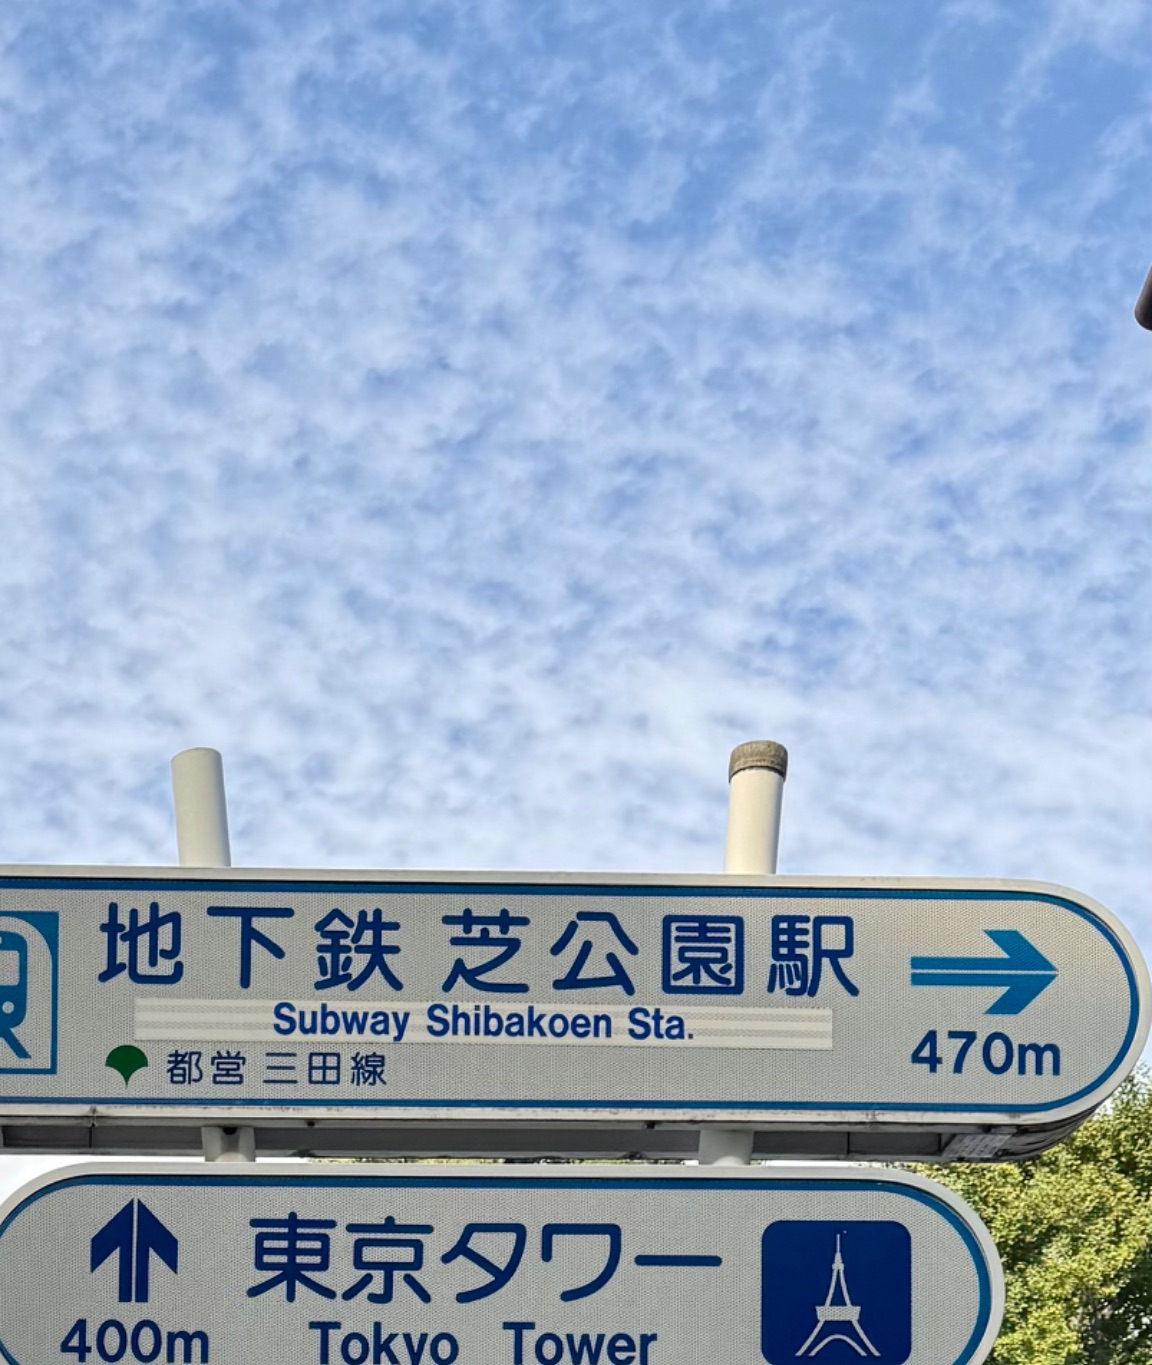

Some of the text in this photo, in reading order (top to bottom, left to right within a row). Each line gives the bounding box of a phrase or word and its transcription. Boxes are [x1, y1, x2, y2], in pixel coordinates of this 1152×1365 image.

[97, 901, 859, 998] 地下鉄芝公園駅
[273, 1002, 694, 1042] Subway Shibakoen Sta.
[910, 1029, 1062, 1077] 470m
[246, 1211, 722, 1304] 東京タワー
[59, 1318, 210, 1365] 400m
